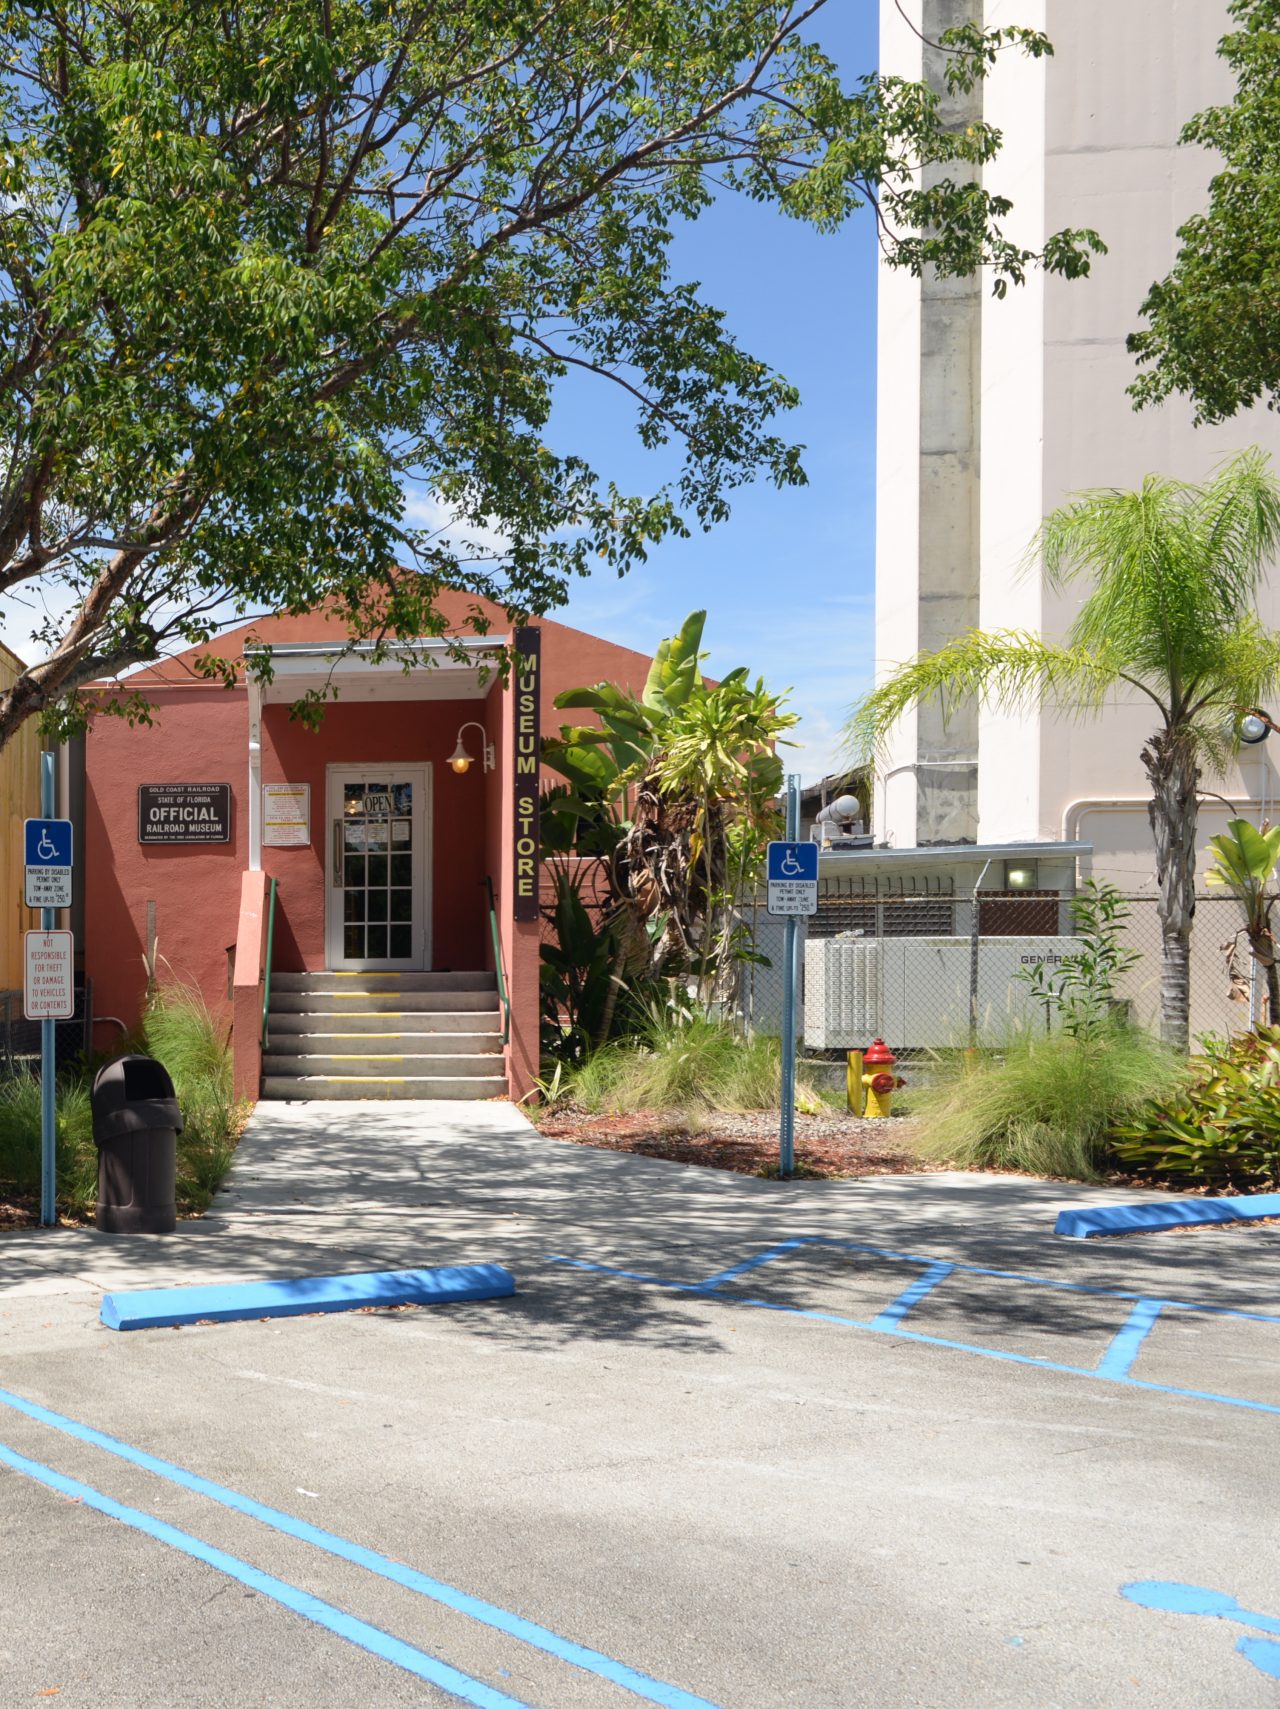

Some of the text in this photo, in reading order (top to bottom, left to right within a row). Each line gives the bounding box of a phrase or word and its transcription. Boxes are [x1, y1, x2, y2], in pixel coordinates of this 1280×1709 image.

[516, 653, 537, 897] MUSEUM STORE
[365, 796, 392, 812] OPEN
[149, 807, 219, 821] OFFICIAL
[146, 823, 222, 833] RAILROAD MUSEUM
[43, 939, 53, 947] NOT
[31, 951, 67, 961] RESPONSIBLE
[1020, 955, 1078, 965] GENER
[35, 963, 63, 973] FOR THEFT
[33, 975, 65, 985] OR DAMAGE
[32, 988, 66, 997] TO VEHICLES
[31, 1000, 67, 1010] OR CONTENTS
